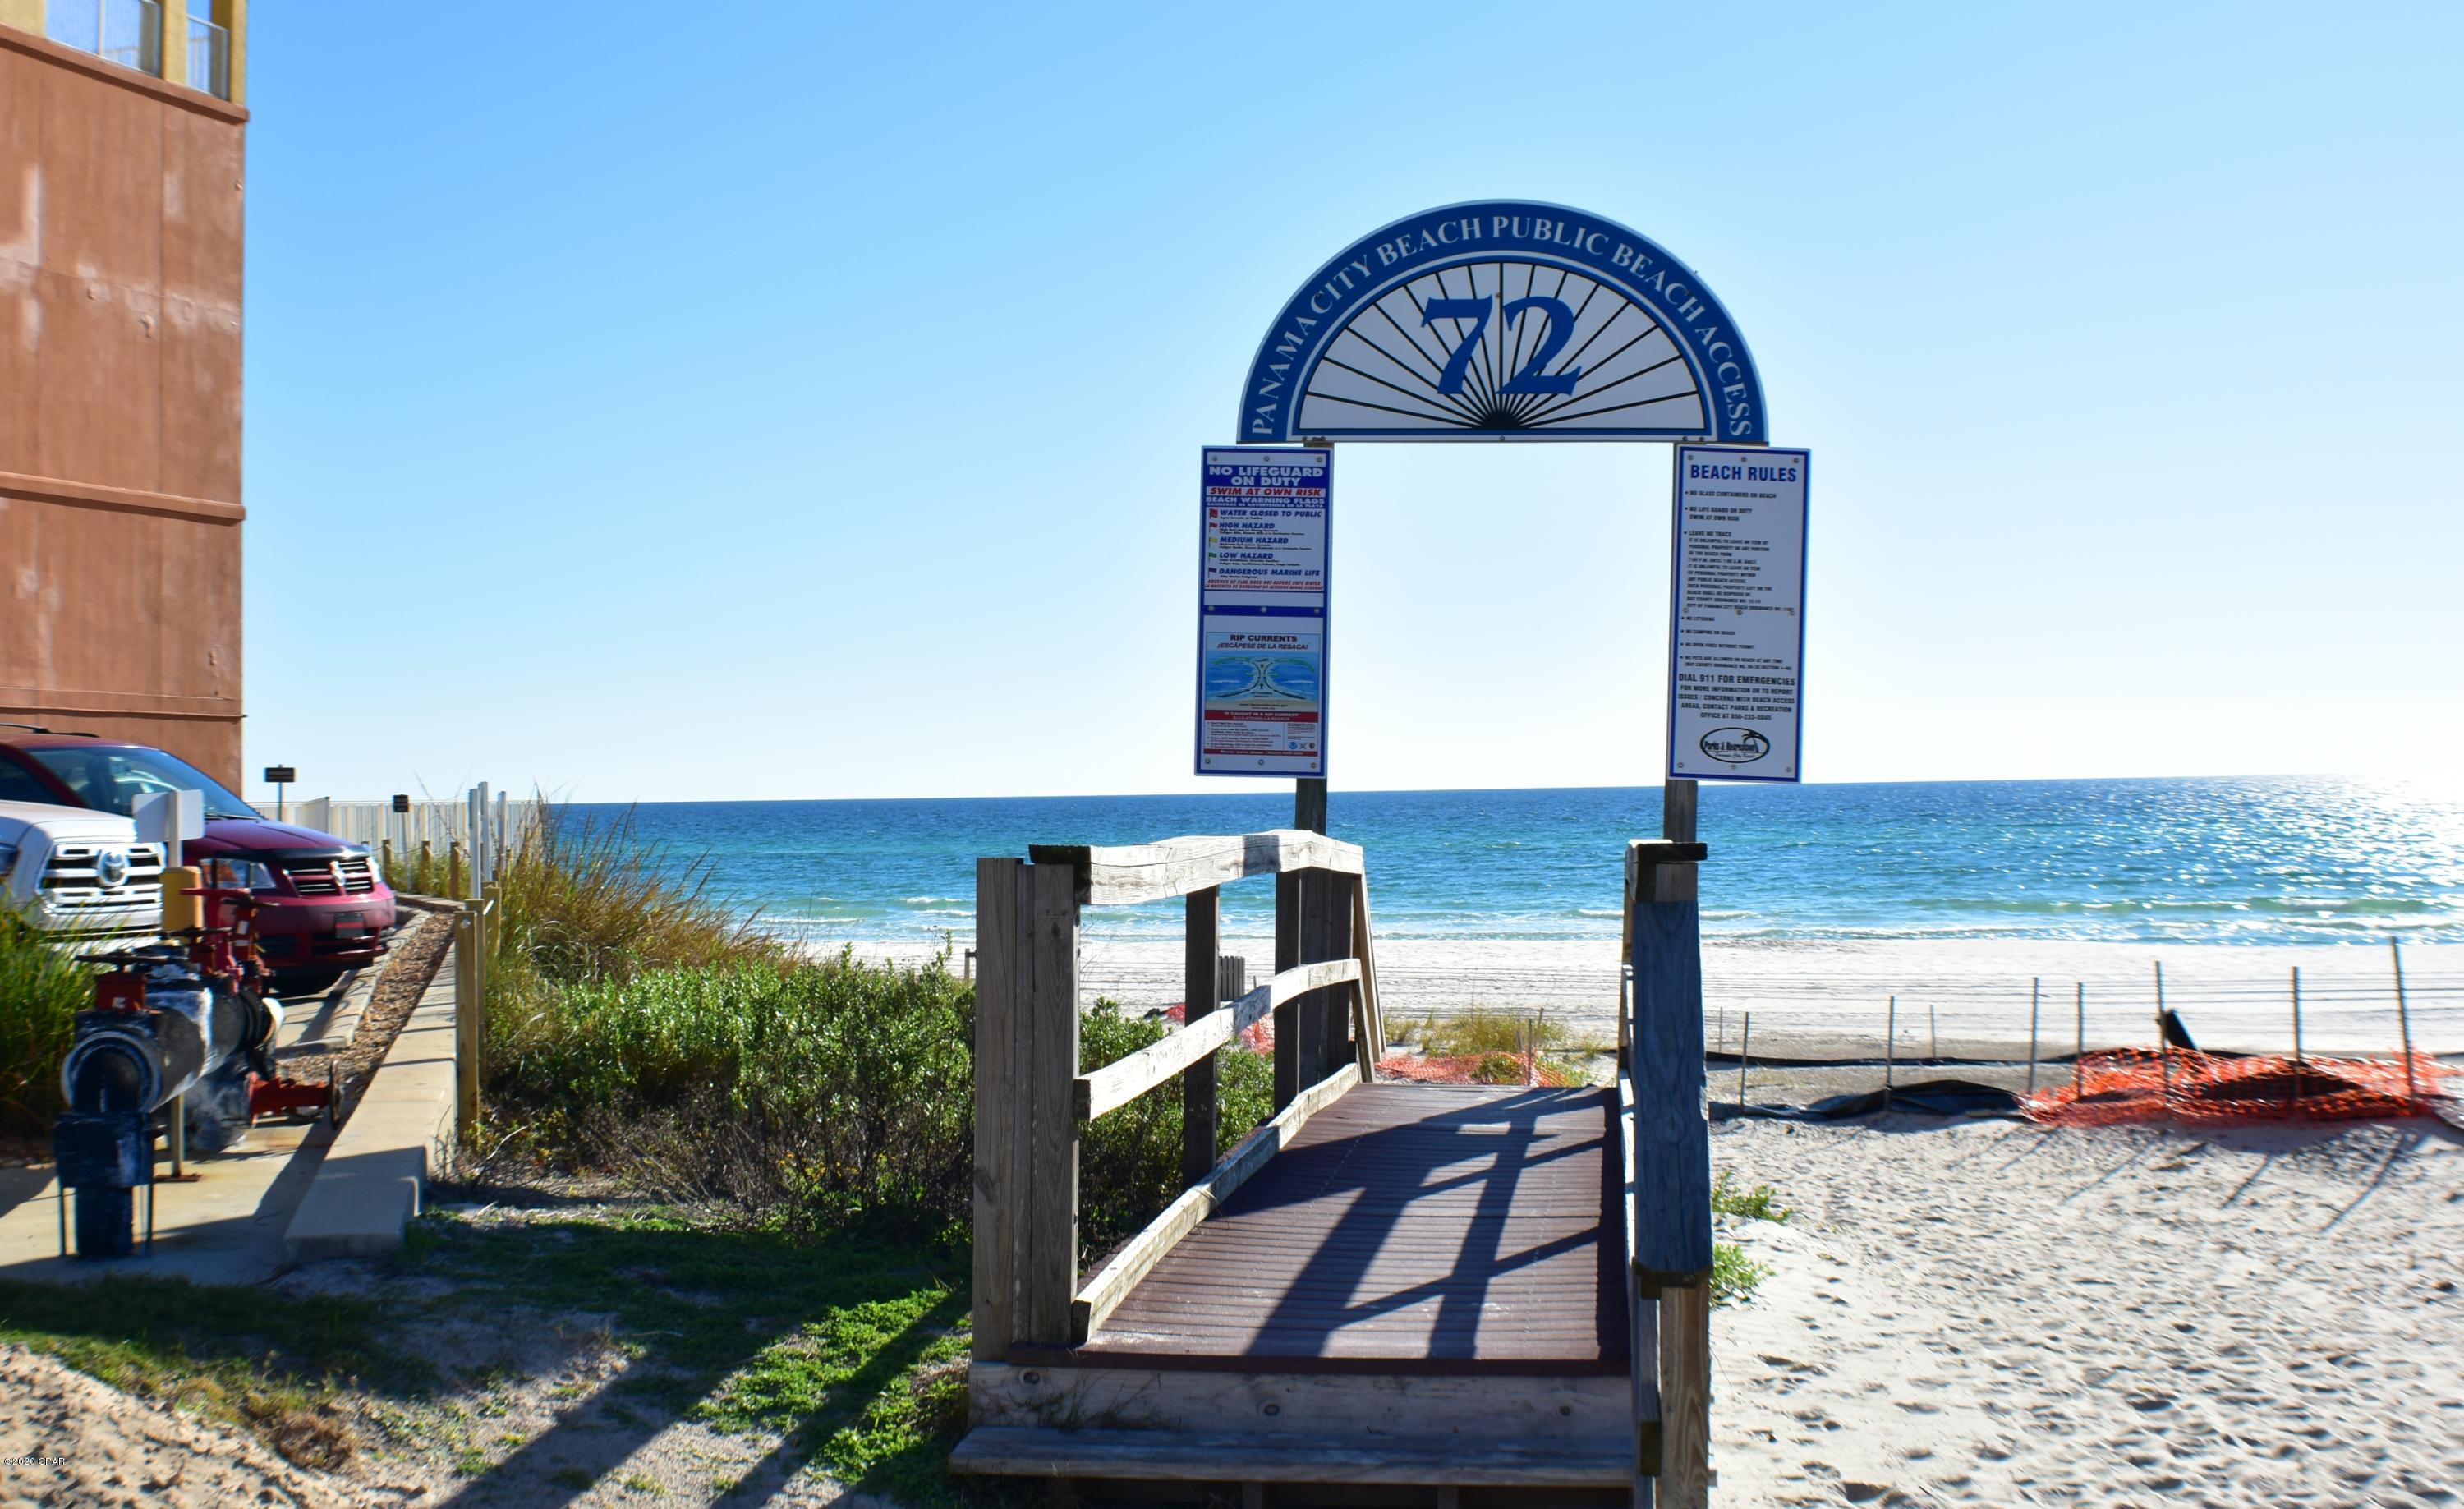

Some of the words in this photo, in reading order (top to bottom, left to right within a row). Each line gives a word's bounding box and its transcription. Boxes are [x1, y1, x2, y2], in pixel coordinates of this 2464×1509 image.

[1252, 315, 1317, 435] PANAMA
[1310, 254, 1372, 314] CITY
[1376, 217, 1482, 267] BEACH
[1492, 216, 1609, 255] PUBLIC
[1611, 243, 1706, 323] BEACH
[1695, 326, 1753, 436] ACCESS
[1420, 295, 1583, 396] 72
[1209, 467, 1233, 476] NO
[1239, 467, 1324, 477] LIFEGUARD
[1690, 464, 1742, 480] BEACH
[1748, 467, 1797, 482] RULES
[1230, 476, 1255, 485] ON
[1261, 476, 1301, 486] DUTY
[1210, 487, 1243, 495] SWIM
[1246, 487, 1261, 495] AT
[1264, 488, 1292, 496] OWN
[1295, 488, 1322, 496] RISK
[1678, 673, 1697, 682] DIAL
[1699, 674, 1714, 683] 911
[1717, 674, 1734, 683] FOR
[1737, 675, 1795, 686] EMERGENCIES
